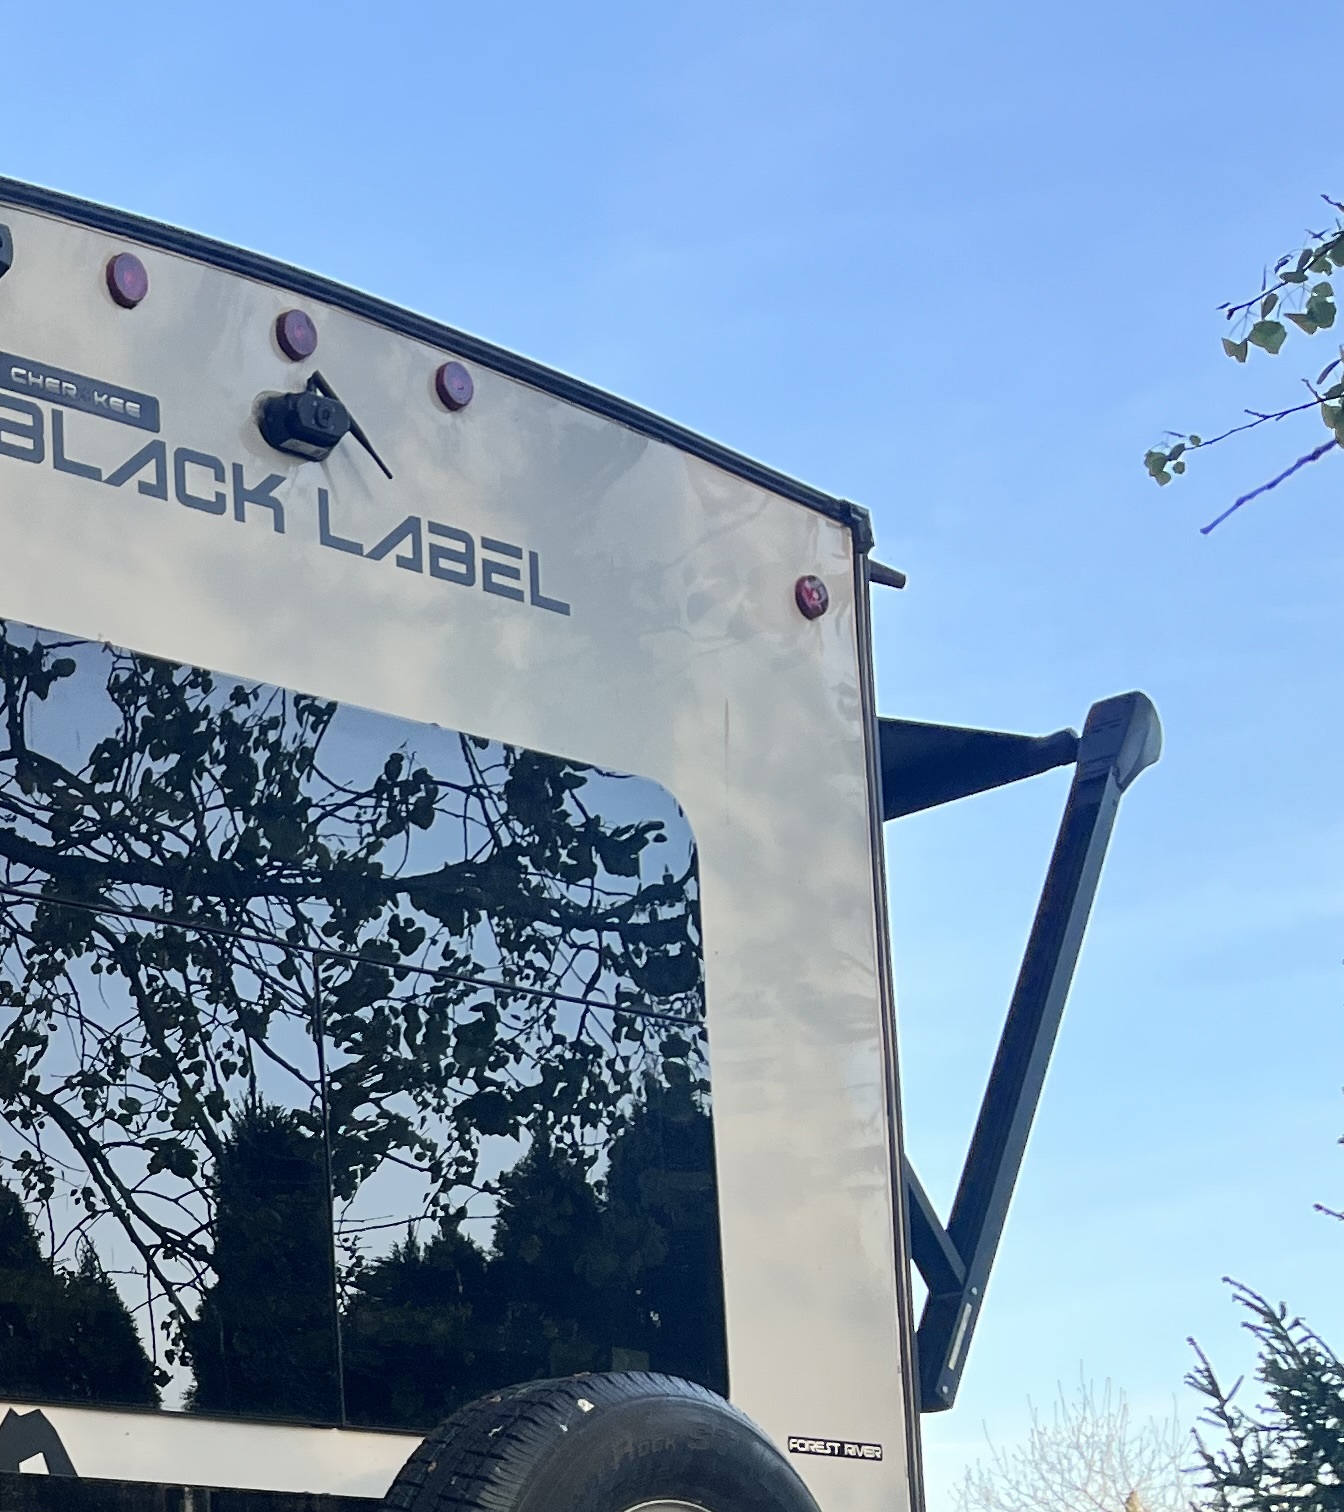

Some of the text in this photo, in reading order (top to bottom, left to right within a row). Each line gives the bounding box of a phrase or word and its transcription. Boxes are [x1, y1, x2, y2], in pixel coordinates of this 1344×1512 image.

[10, 366, 142, 419] CHERKEE
[317, 487, 571, 616] LABEL
[789, 1439, 881, 1459] FOREST RIVER
